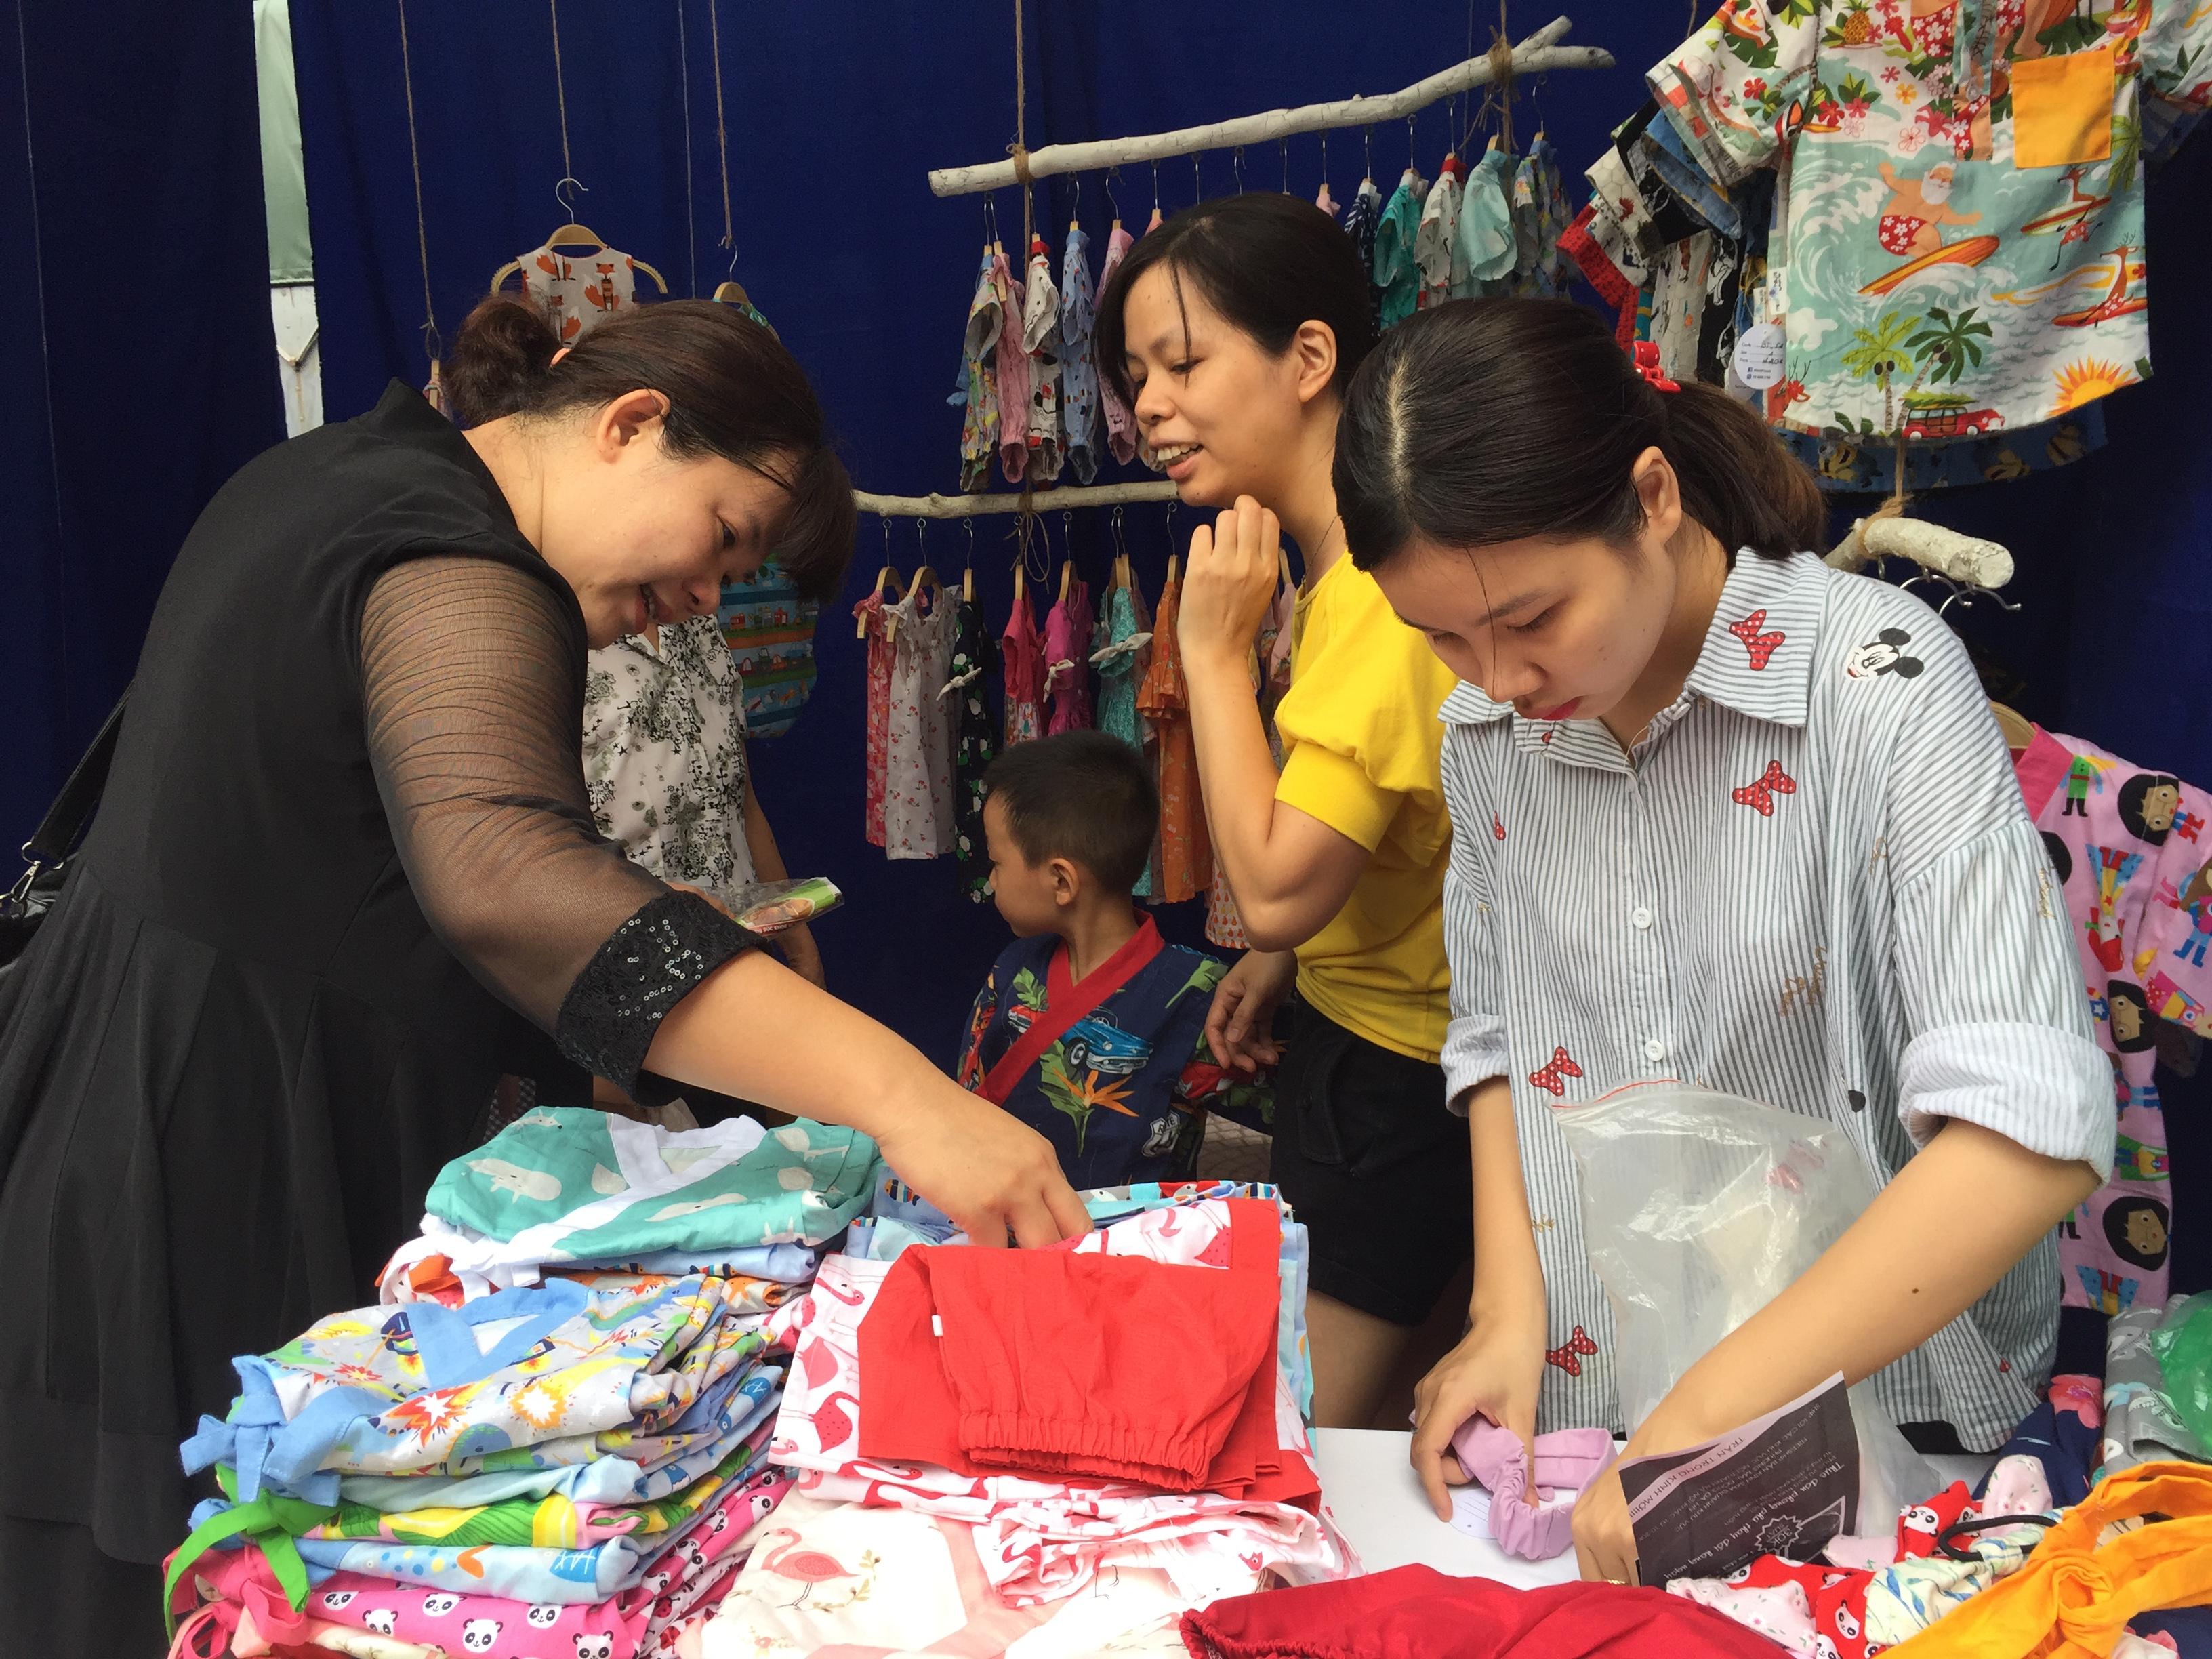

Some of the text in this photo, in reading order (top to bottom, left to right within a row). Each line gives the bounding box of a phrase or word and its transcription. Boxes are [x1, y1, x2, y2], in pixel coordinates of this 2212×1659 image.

[1677, 1455, 1715, 1478] TRỌNG
[1652, 1474, 1677, 1497] KÍNH
[1767, 1490, 1800, 1512] phong
[1729, 1521, 1753, 1541] thay
[1767, 1527, 1793, 1549] 30K
